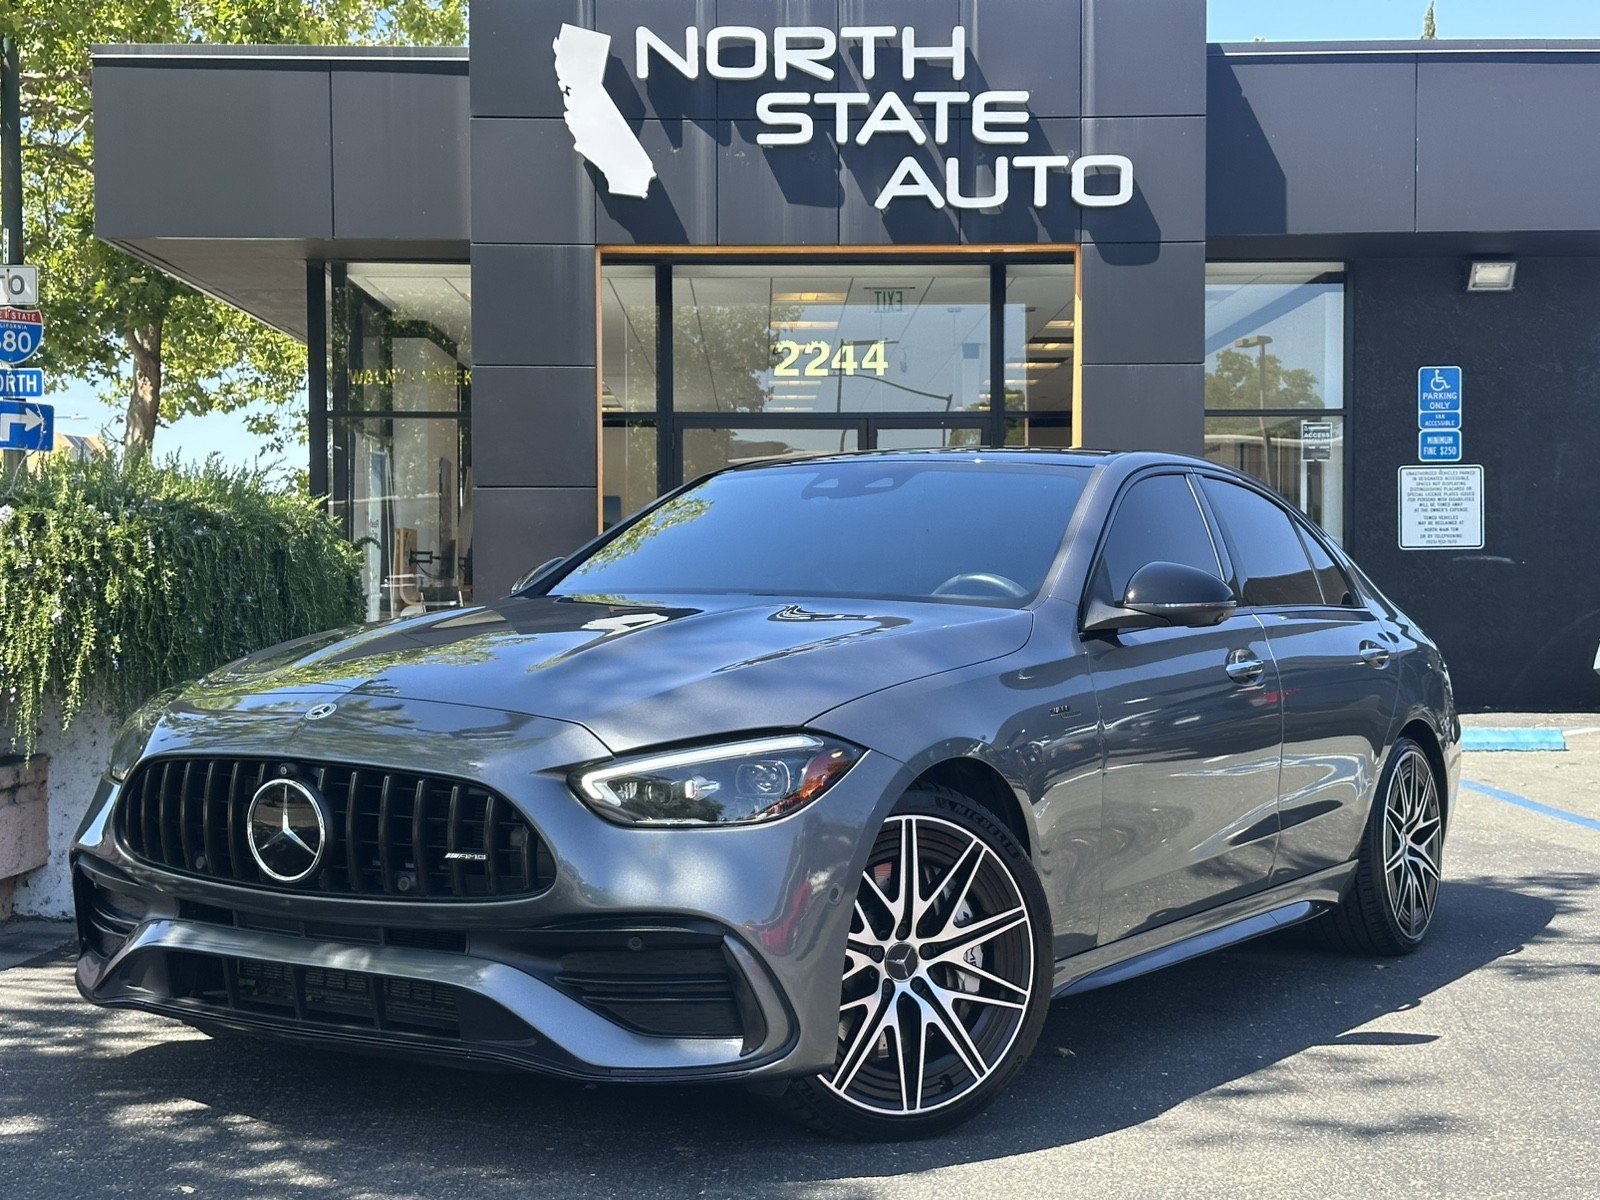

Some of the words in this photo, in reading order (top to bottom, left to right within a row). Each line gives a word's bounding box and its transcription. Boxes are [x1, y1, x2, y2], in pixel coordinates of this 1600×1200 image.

[636, 26, 965, 81] NORTH
[756, 91, 1029, 146] STATE
[874, 154, 1133, 208] AUTO
[0, 274, 25, 295] O
[0, 329, 32, 353] 80
[773, 340, 889, 376] 2244
[1422, 392, 1458, 400] PARKING
[1429, 401, 1450, 409] ONLY
[1423, 447, 1437, 455] FINE
[1440, 446, 1457, 456] $250
[1427, 436, 1453, 444] MINIMUM
